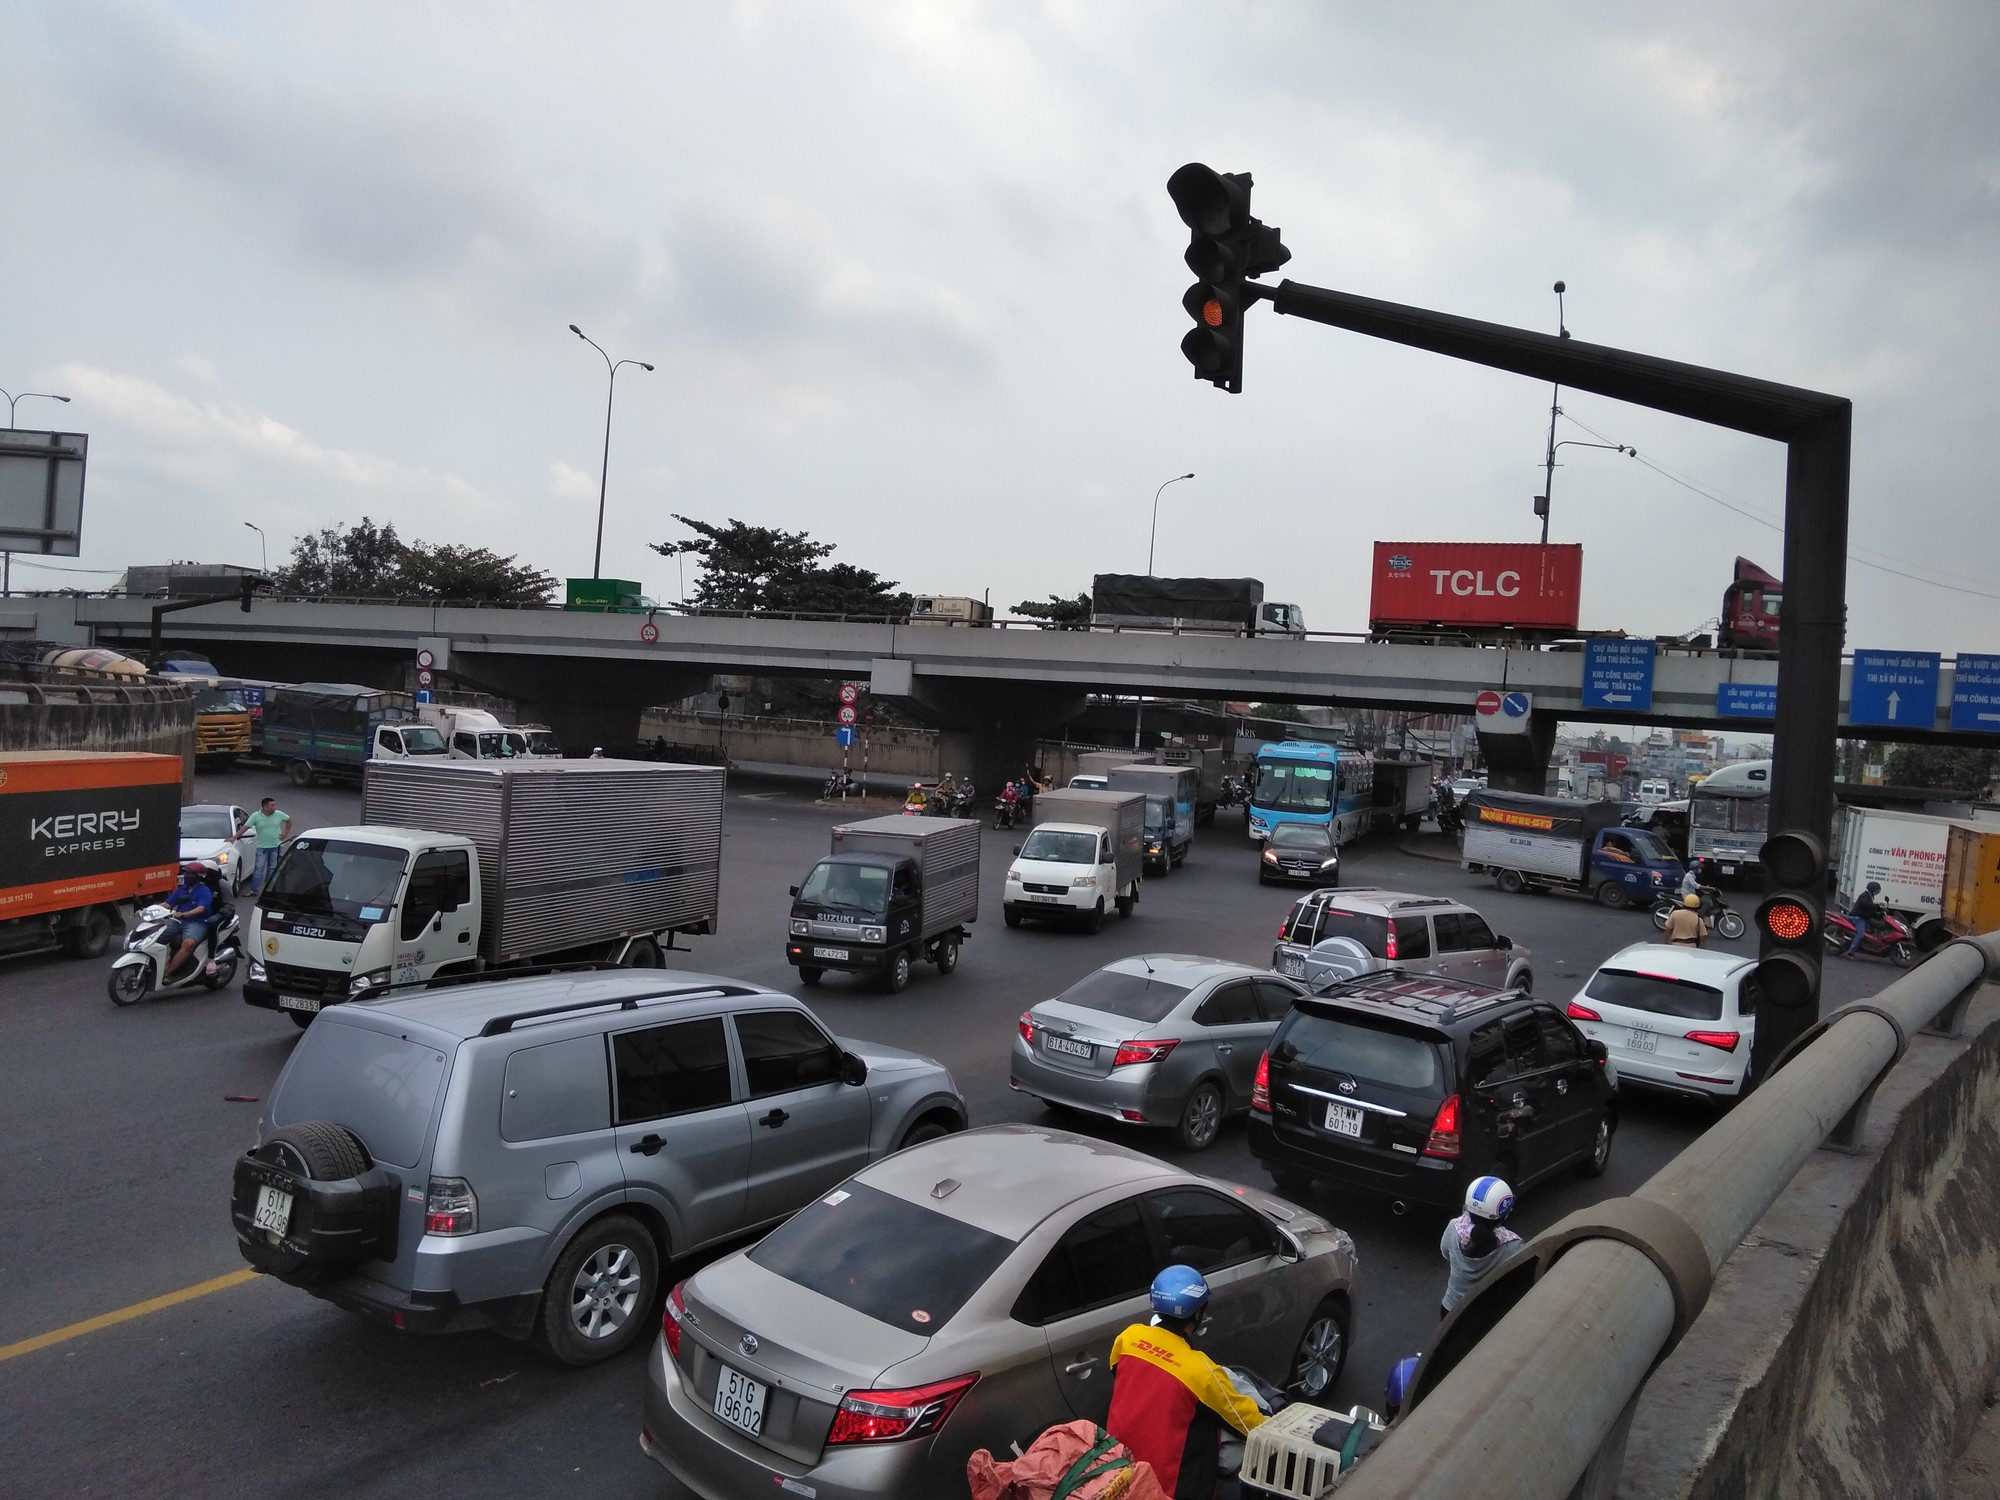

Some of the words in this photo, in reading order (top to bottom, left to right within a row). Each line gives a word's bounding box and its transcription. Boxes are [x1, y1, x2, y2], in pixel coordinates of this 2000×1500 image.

[1430, 570, 1520, 597] TCLC
[1593, 644, 1605, 653] CHỢ
[1632, 645, 1648, 654] NÔNG
[1608, 654, 1619, 664] THỦ
[1864, 657, 1885, 667] THÀNH
[1886, 657, 1899, 667] PHỐ
[1901, 658, 1916, 668] BIÊN
[1960, 658, 1972, 669] CẦU
[1974, 660, 1989, 671] VƯỢT
[1606, 670, 1621, 679] CÔNG
[1623, 671, 1645, 681] NGHIỆP
[1867, 674, 1878, 684] THỊ
[1880, 673, 1888, 683] XÃ
[1899, 675, 1907, 684] AN
[1956, 672, 1968, 683] THỦ
[1612, 680, 1627, 690] THẦN
[1955, 694, 1968, 702] KHU
[1970, 693, 1989, 704] CÔNG
[1236, 728, 1256, 738] PARIS
[31, 808, 140, 841] KERRY
[45, 838, 126, 857] EXPRESS
[1869, 847, 1883, 855] CÔNG
[1891, 847, 1907, 858] VĂN
[1909, 850, 1936, 862] PHÒNG
[817, 913, 855, 924] SUZUKI
[292, 926, 327, 938] ISUZU
[1634, 1032, 1649, 1041] 51F
[1329, 1118, 1358, 1135] 601-19
[268, 1190, 286, 1213] 61A
[1137, 1340, 1174, 1364] DHL
[729, 1372, 756, 1404] 51G
[718, 1391, 761, 1434] 196.02
